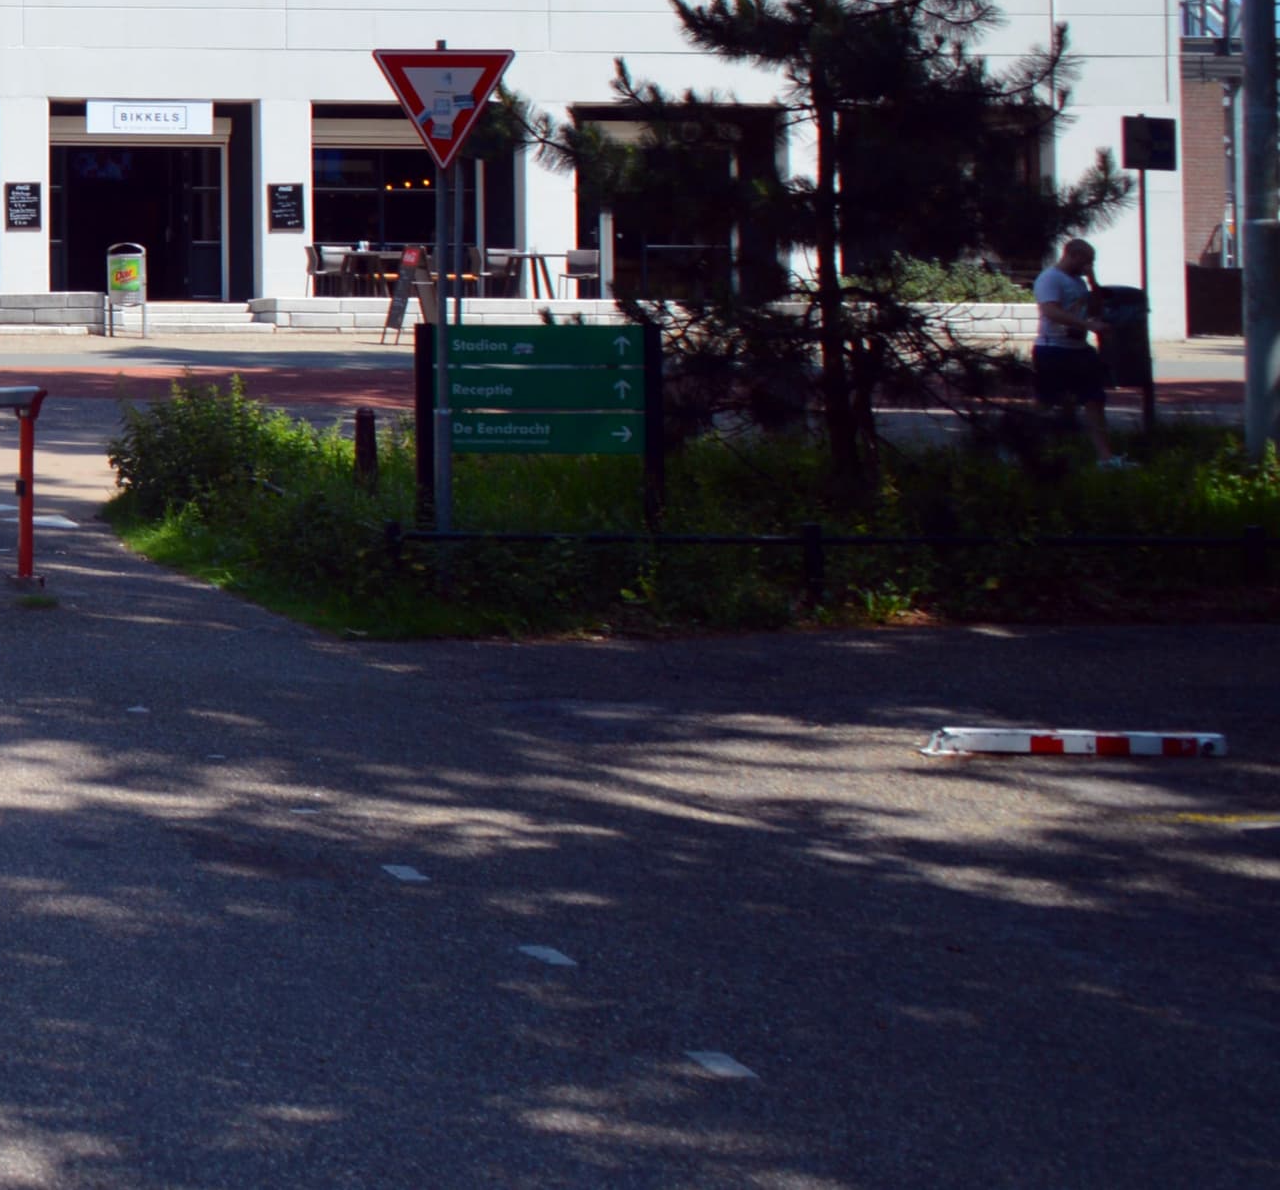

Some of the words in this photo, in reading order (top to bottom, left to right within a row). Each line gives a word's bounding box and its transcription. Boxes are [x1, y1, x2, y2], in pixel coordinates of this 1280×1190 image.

[120, 112, 180, 122] BIKKELS
[452, 339, 508, 352] Stadion
[452, 384, 513, 397] Receptie
[453, 423, 472, 435] De
[477, 422, 551, 435] Eendracht
